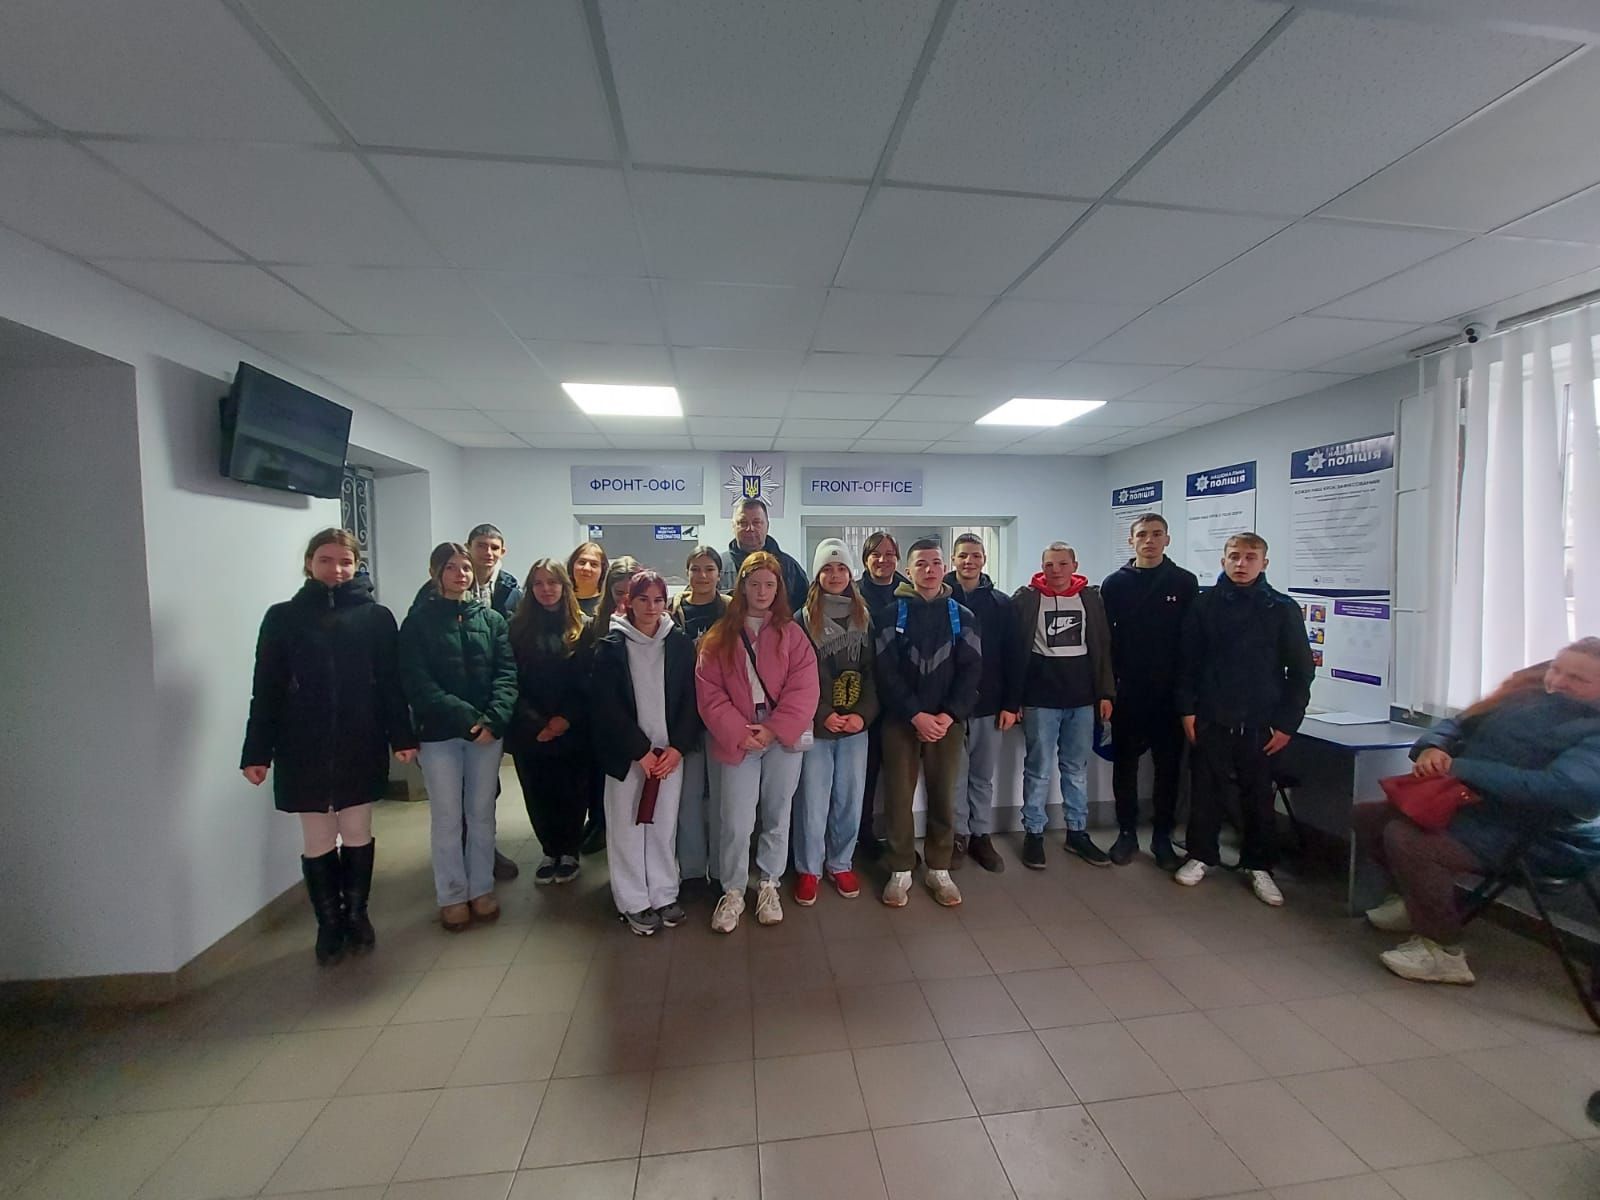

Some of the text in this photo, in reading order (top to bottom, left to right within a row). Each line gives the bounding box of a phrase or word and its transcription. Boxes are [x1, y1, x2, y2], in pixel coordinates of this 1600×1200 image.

[1327, 449, 1381, 467] ПОЛІЦІЯ
[590, 479, 685, 491] ФРОНТ-ОФІС
[811, 480, 913, 493] FRONT-OFFICE
[1210, 474, 1246, 488] ПОЛІЦІЯ
[1129, 490, 1155, 500] ПОЛІЦІЯ
